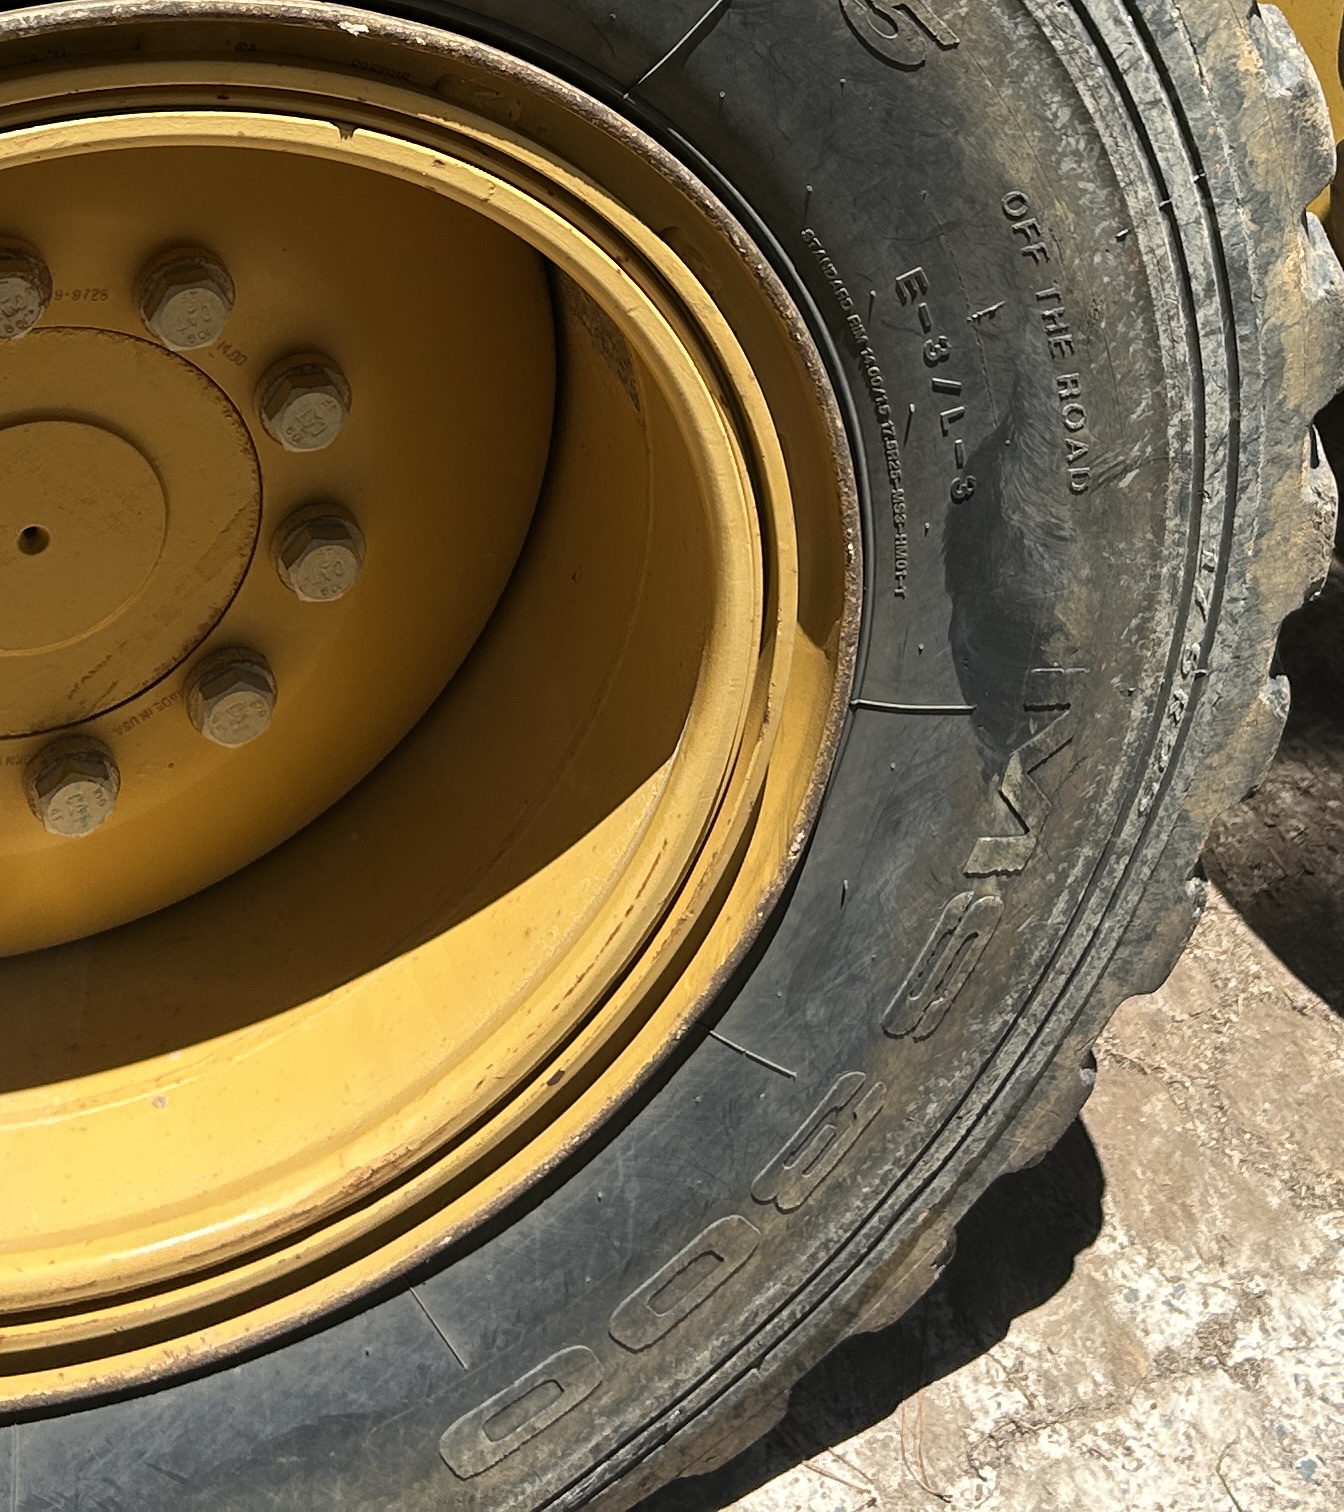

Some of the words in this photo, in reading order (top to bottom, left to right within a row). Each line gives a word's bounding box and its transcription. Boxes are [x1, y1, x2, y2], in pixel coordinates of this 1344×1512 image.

[800, 228, 857, 315] STANDARD
[1001, 190, 1052, 265] OFF
[1035, 286, 1075, 359] THE
[1057, 371, 1091, 496] ROAD
